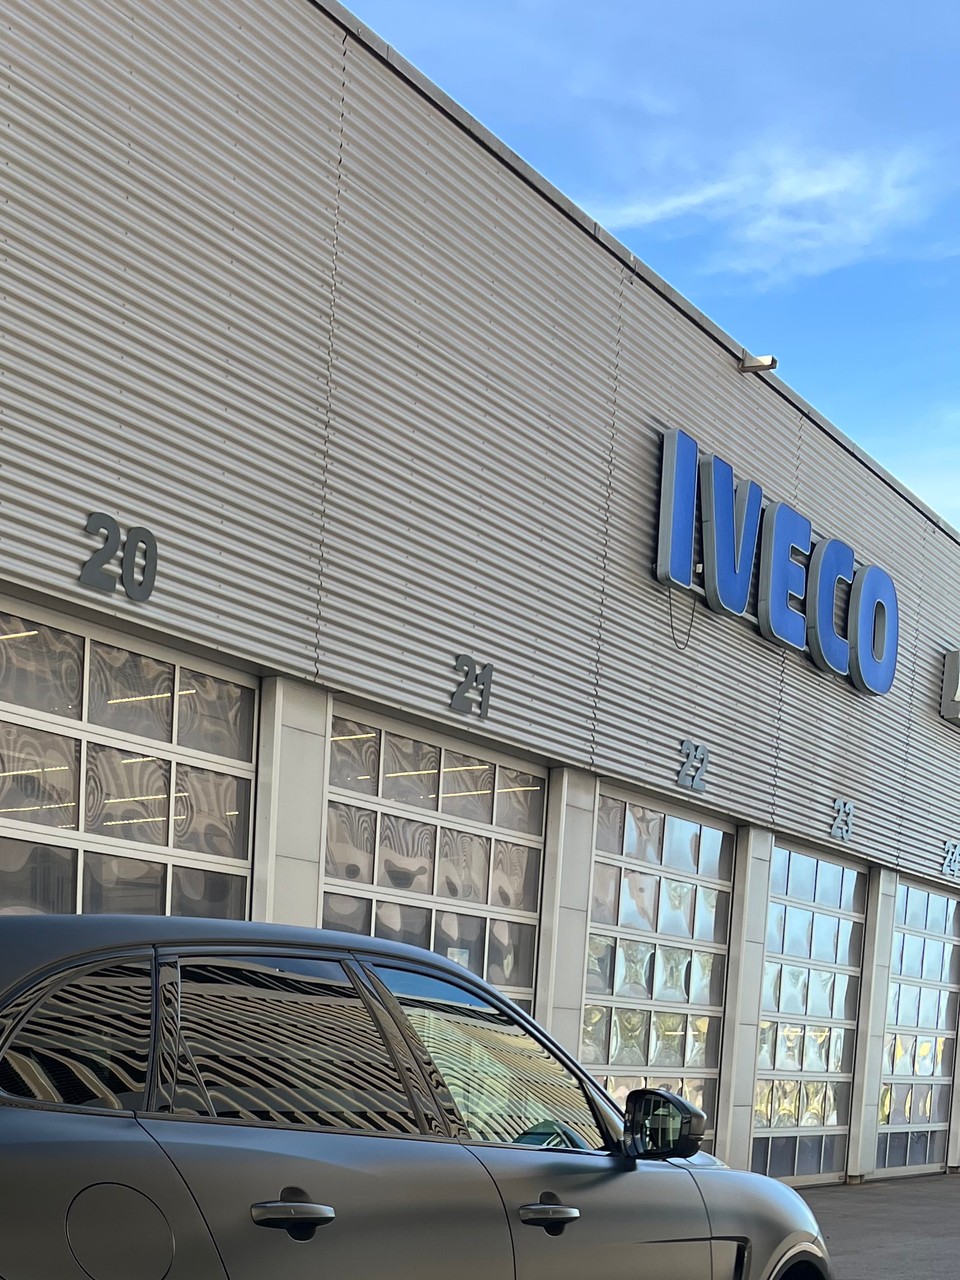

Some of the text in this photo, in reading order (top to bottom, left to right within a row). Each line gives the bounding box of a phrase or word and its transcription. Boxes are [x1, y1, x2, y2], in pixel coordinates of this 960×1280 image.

[79, 512, 158, 601] 20
[657, 427, 899, 697] IVECO
[450, 653, 494, 719] 21
[676, 739, 709, 792] 22
[830, 799, 854, 841] 23
